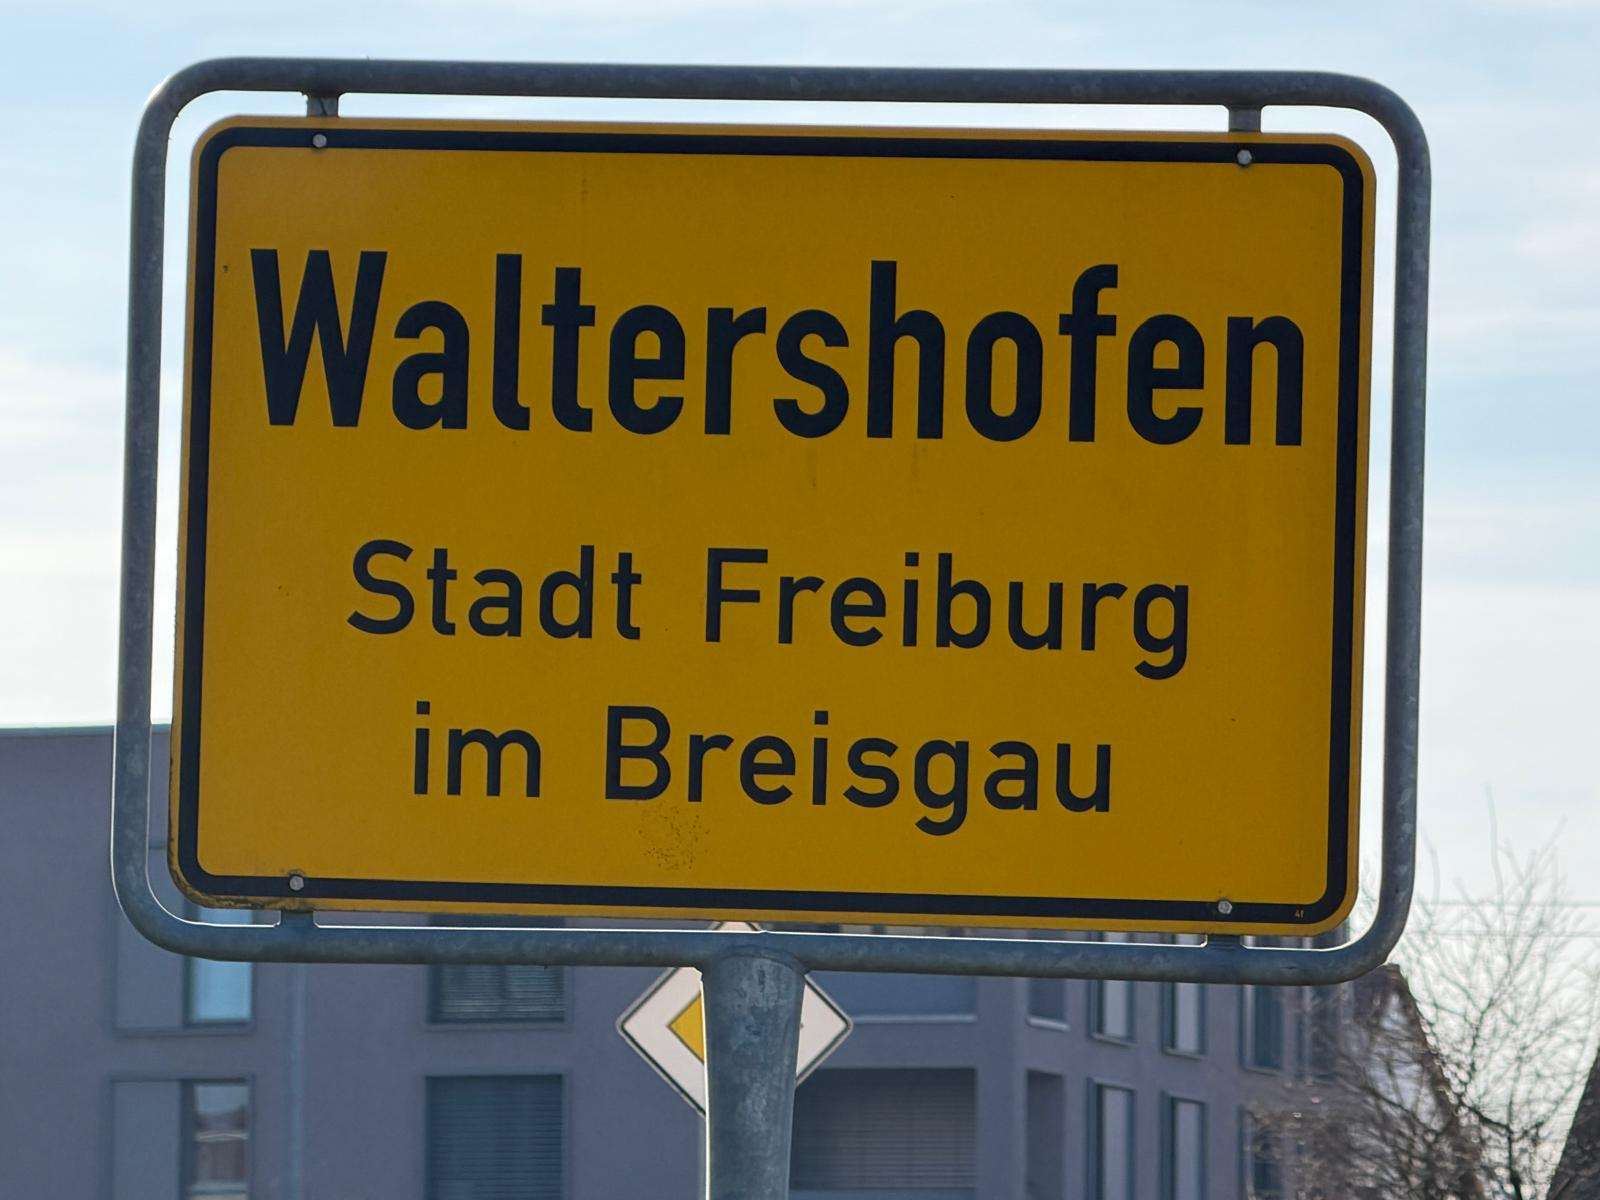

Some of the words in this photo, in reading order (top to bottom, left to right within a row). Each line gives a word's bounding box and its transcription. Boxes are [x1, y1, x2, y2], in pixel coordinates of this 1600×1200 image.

[251, 249, 1305, 446] Waltershofen
[347, 540, 642, 640] Stadt
[705, 548, 1189, 680] Freiburg
[414, 701, 541, 798] im
[605, 706, 1111, 836] Breisgau
